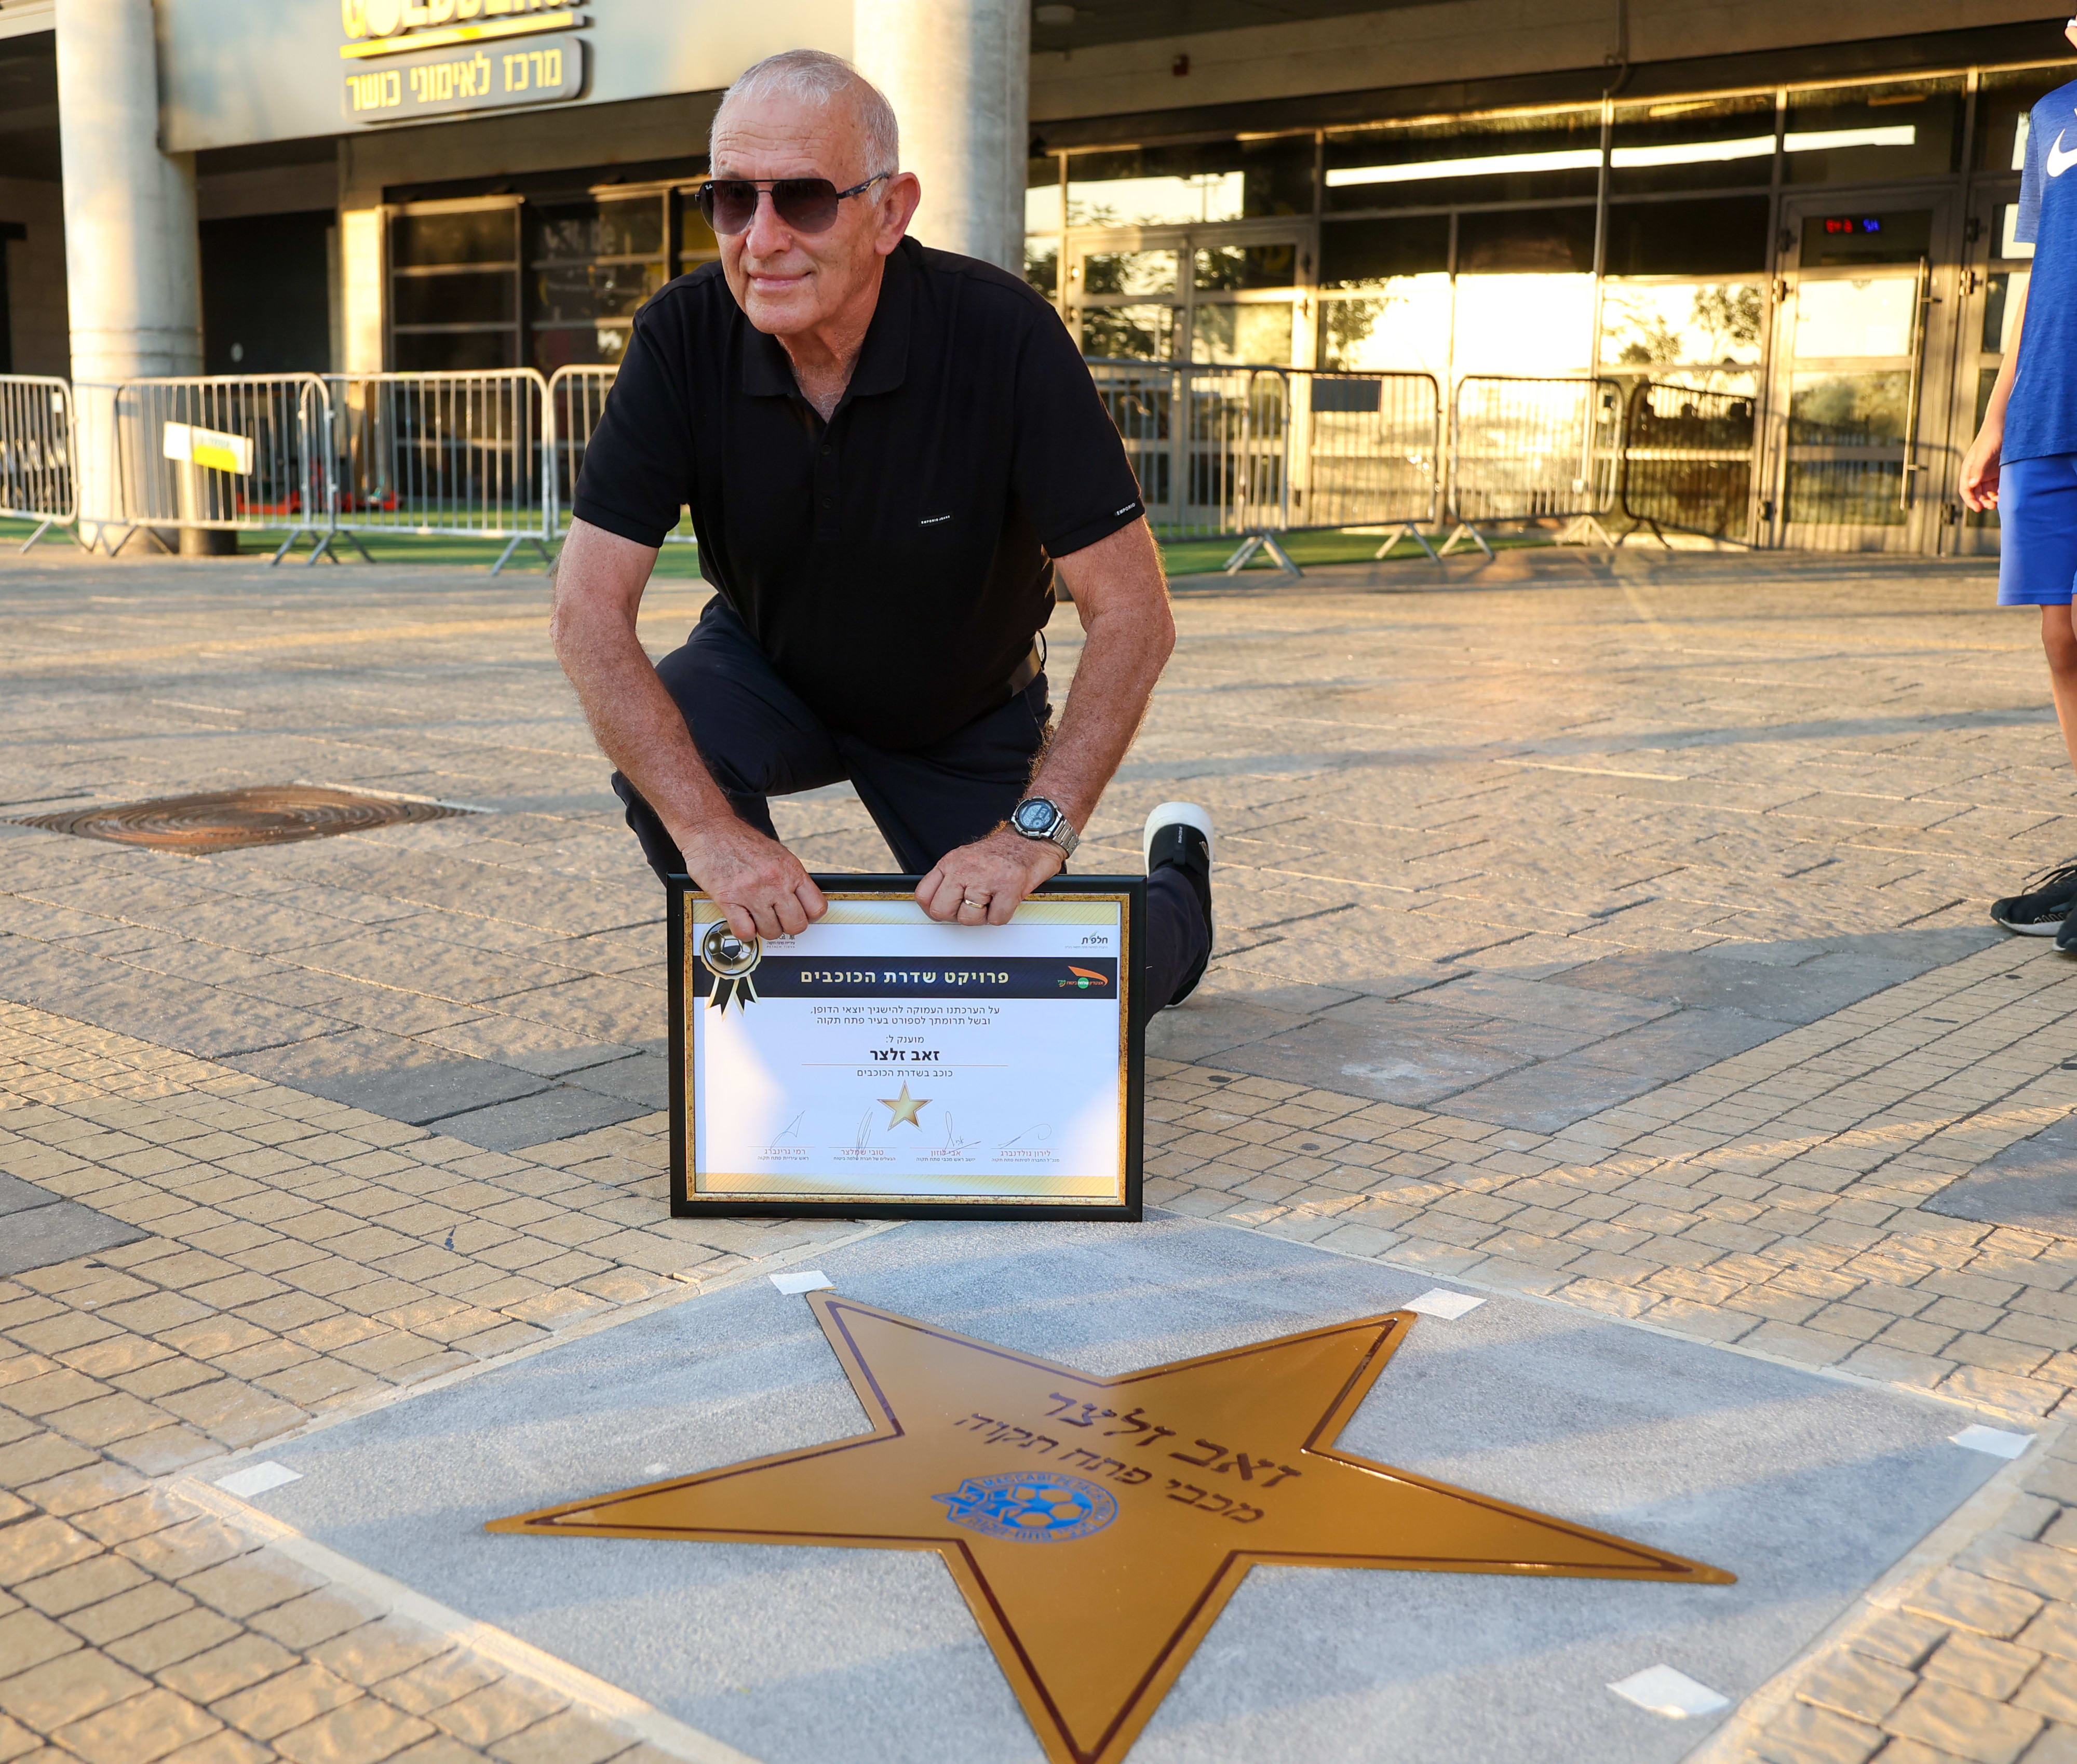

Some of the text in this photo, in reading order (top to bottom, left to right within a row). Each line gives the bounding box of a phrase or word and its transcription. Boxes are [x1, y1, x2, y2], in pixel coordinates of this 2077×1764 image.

[346, 48, 562, 111] מרכז לאימוני כושר
[1116, 503, 1136, 516] EMPORIO
[801, 971, 1008, 985] פרויקט שדרת הכוכבים
[810, 1006, 839, 1015] הדופן,
[868, 1005, 903, 1015] להישגיך
[907, 1007, 943, 1015] העמוקה
[989, 1005, 1000, 1014] על
[892, 1016, 926, 1025] לספורט
[929, 1018, 965, 1026] תרומתך
[968, 1016, 990, 1025] ובשל
[886, 1034, 894, 1043] ל:
[870, 1047, 940, 1061] זאב זלצר
[953, 1412, 1264, 1523] מכבי פתח תקוה
[1168, 1438, 1302, 1488] זאב
